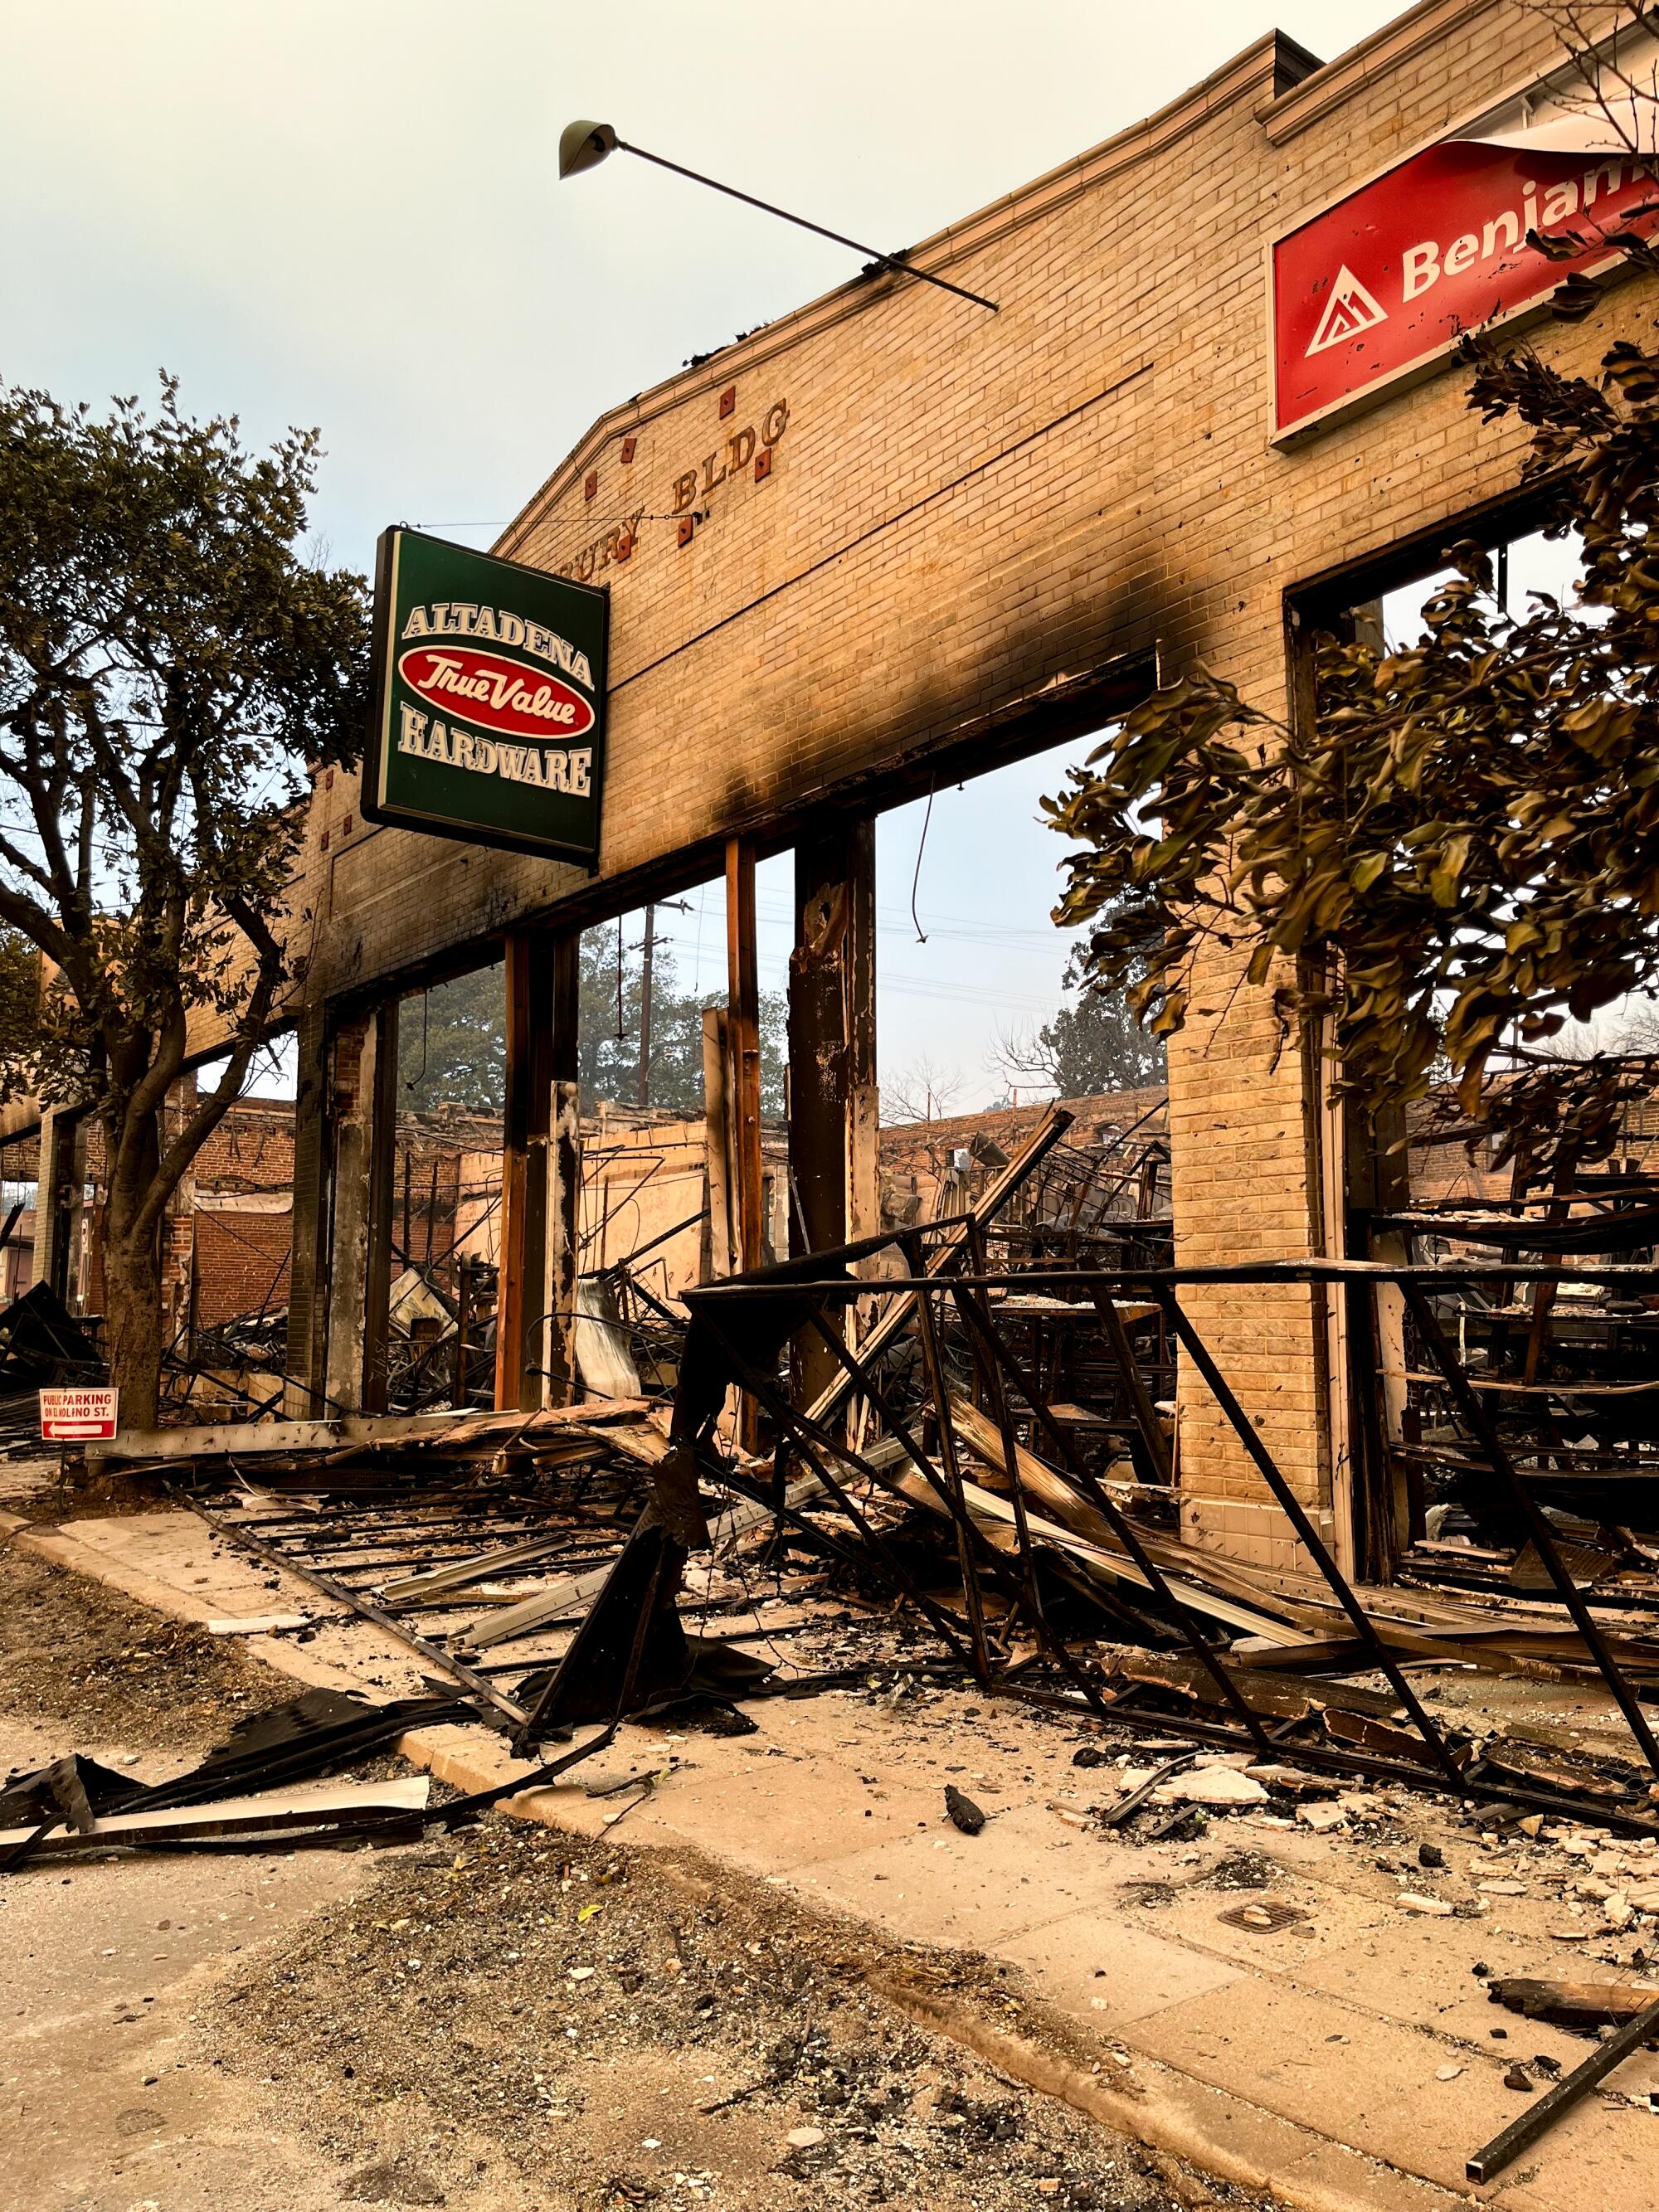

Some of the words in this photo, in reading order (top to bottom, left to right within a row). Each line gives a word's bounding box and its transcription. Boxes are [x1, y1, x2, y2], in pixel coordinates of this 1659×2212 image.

[671, 397, 790, 516] BLDG
[401, 602, 596, 692] ALTADENA
[397, 700, 592, 798] HARDWARE
[43, 1394, 62, 1406] PUBLIC
[62, 1393, 112, 1405] PARKING
[45, 1407, 53, 1417] ON
[53, 1407, 58, 1417] EL
[59, 1407, 90, 1417] MOLINO
[94, 1407, 109, 1417] ST.
